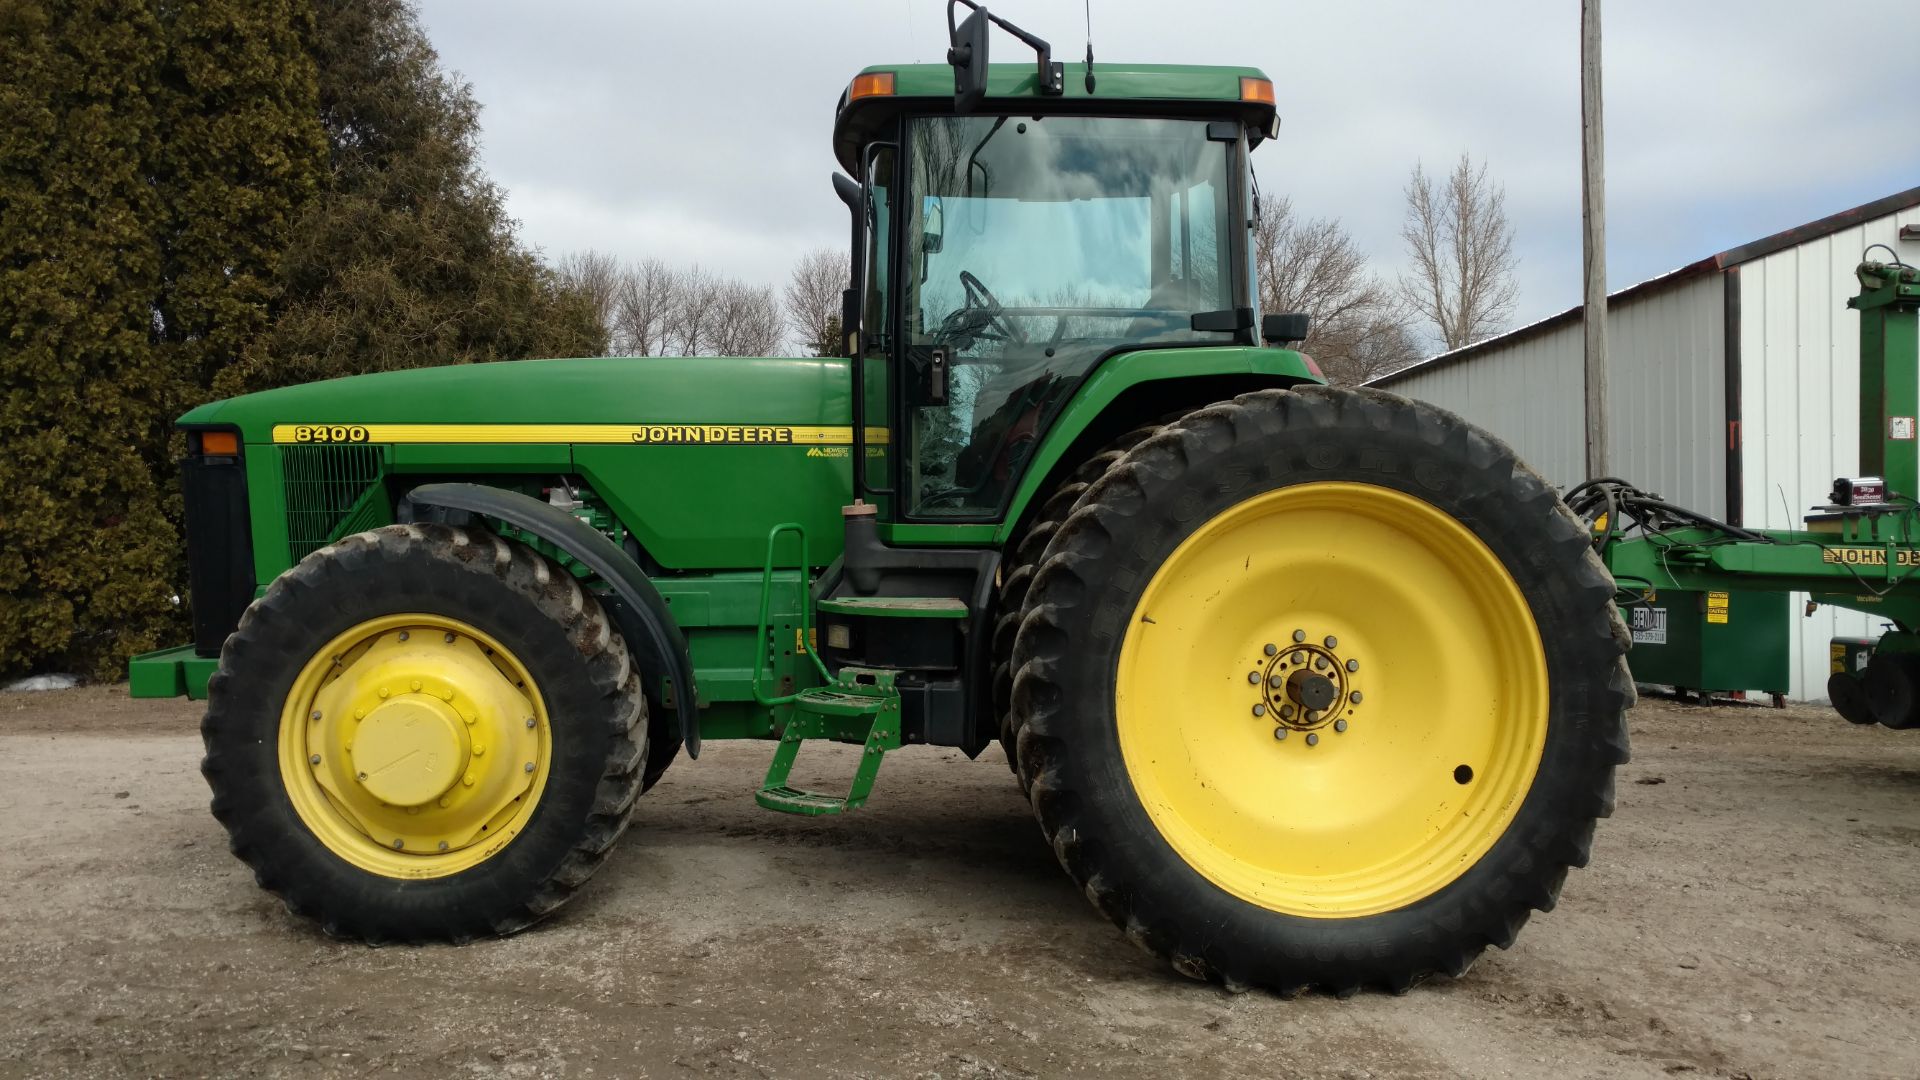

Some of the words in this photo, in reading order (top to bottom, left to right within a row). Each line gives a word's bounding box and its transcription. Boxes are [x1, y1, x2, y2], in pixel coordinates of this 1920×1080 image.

[295, 426, 369, 443] 8400
[632, 427, 705, 443] JOHN
[709, 427, 792, 444] DEERE
[1833, 549, 1888, 565] JOHN
